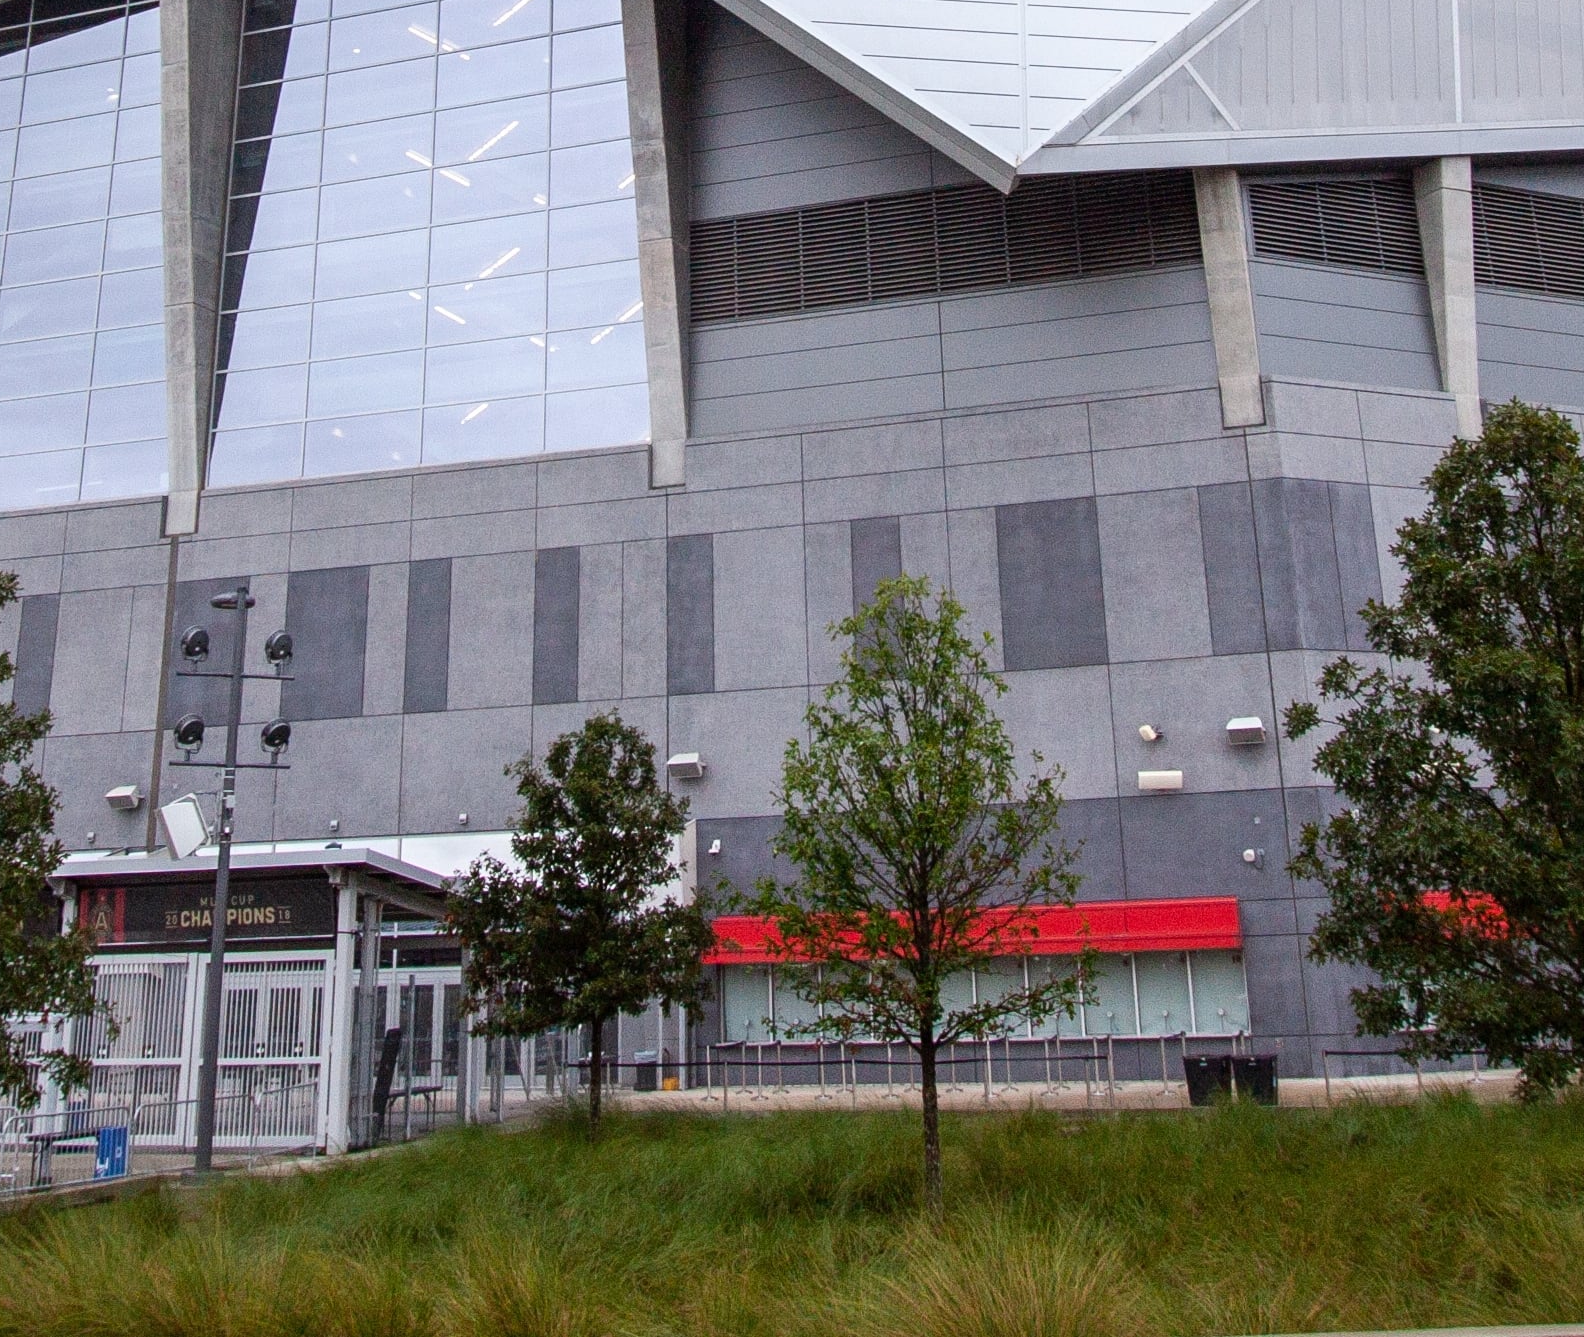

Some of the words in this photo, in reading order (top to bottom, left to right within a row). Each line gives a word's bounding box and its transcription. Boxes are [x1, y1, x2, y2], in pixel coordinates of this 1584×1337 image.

[231, 894, 255, 906] CUP
[180, 906, 276, 928] CHAPIONS
[278, 909, 291, 920] 18
